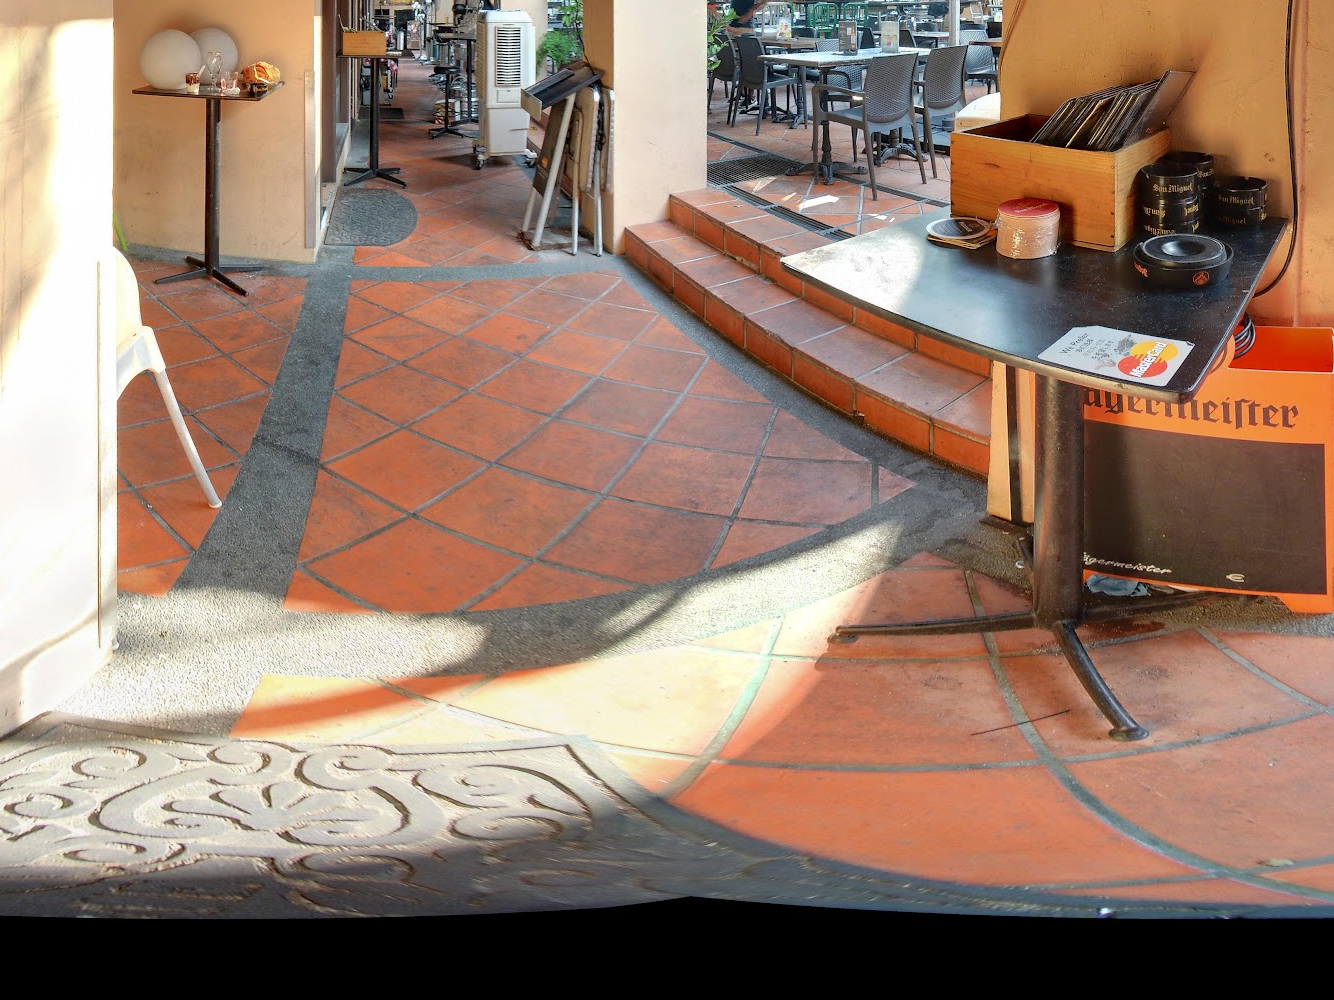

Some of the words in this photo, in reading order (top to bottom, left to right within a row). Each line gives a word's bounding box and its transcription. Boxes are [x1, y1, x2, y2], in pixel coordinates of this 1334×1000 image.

[1153, 184, 1167, 193] San
[1168, 183, 1193, 194] Miguel
[1229, 196, 1254, 205] Miguel
[1059, 345, 1073, 354] We
[1129, 341, 1168, 378] MasterCard
